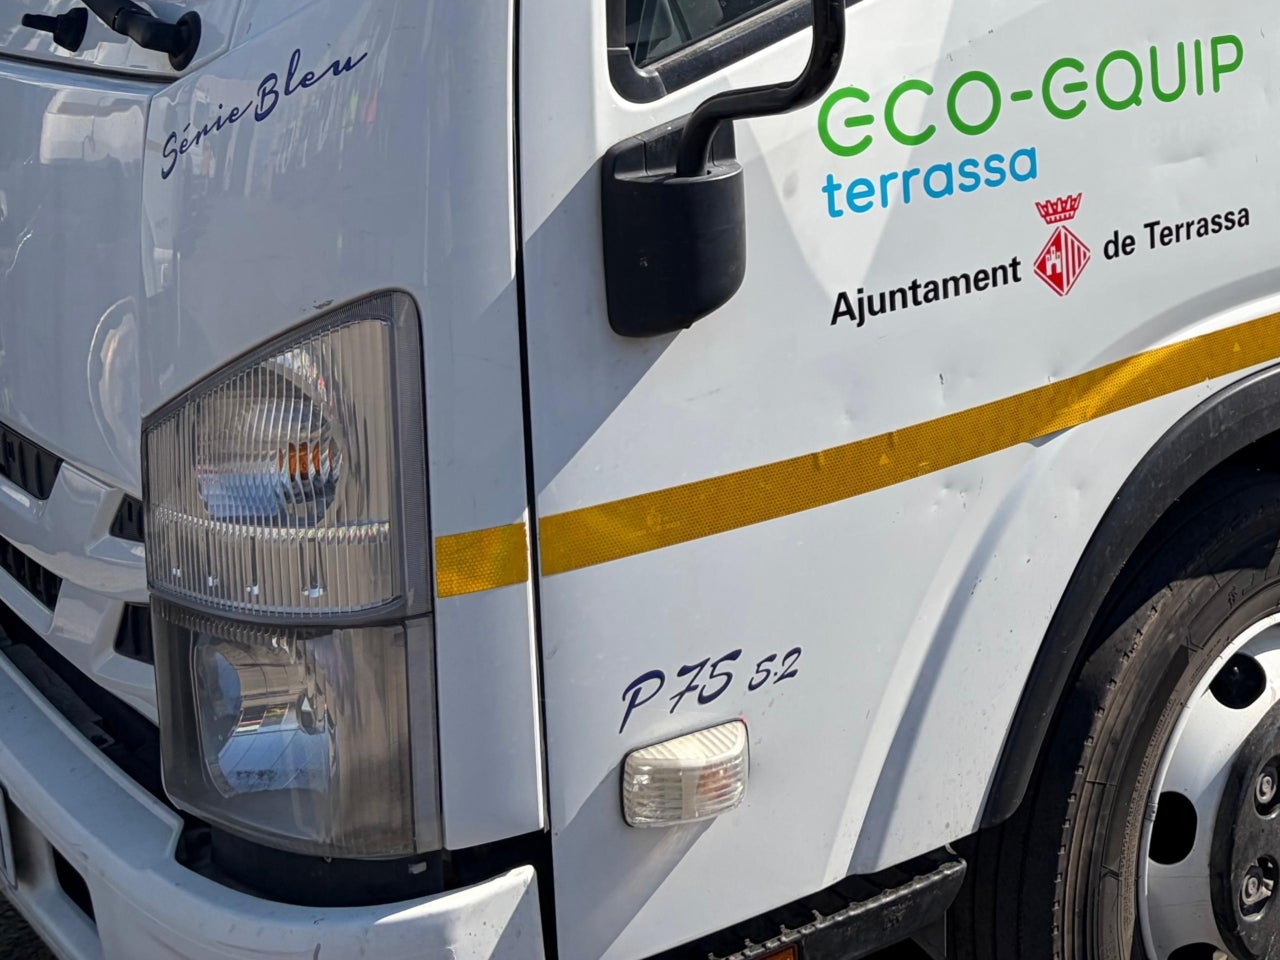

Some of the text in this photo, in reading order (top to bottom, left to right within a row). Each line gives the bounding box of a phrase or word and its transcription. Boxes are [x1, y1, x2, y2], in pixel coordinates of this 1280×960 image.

[254, 48, 368, 122] Bleu
[821, 145, 1038, 219] terrassa
[829, 206, 1251, 328] Ajuntament de Terrassa
[747, 645, 802, 692] 5.2
